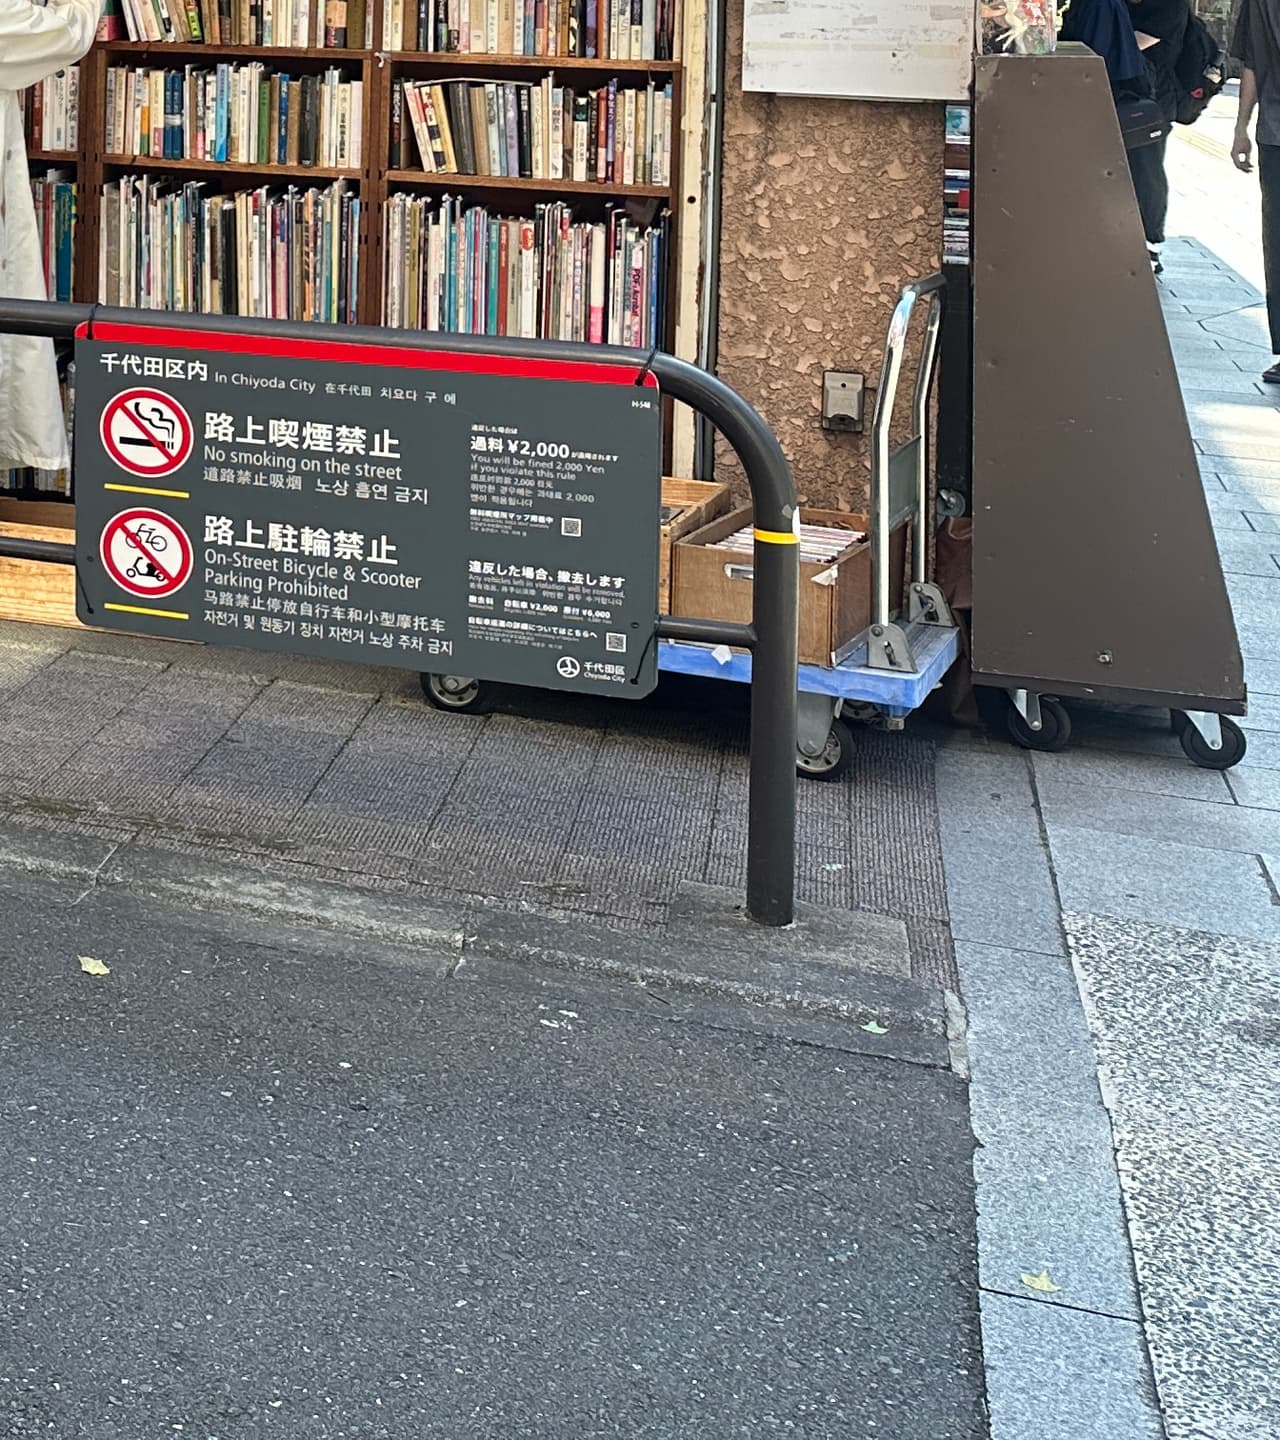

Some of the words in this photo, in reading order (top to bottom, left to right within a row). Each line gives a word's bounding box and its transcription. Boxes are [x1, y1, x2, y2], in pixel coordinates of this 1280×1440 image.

[100, 353, 208, 381] 千代田区内
[215, 372, 227, 383] In
[232, 373, 286, 390] Chiyoda
[290, 379, 316, 394] City
[425, 390, 437, 403] 구
[204, 412, 401, 459] 路上喫煙禁止
[471, 436, 504, 453] 過料
[507, 439, 570, 458] ¥2,000
[204, 447, 225, 461] No
[230, 451, 296, 472] smoking
[301, 458, 321, 472] on
[325, 457, 351, 475] the
[355, 462, 403, 480] street
[471, 454, 490, 463] You
[493, 456, 510, 465] will
[513, 458, 526, 466] be
[528, 460, 553, 470] fined
[585, 464, 605, 474] Yen
[480, 465, 498, 474] you
[501, 466, 533, 477] violate
[536, 469, 554, 479] this
[557, 471, 576, 480] rule
[203, 466, 302, 491] 道路禁止吸烟
[315, 479, 349, 497] 노상
[355, 482, 388, 500] 흡연
[394, 486, 428, 504] 금지
[204, 515, 398, 565] 路上駐輪禁止
[205, 549, 279, 571] On-Street
[283, 555, 338, 579] Bicycle
[343, 566, 355, 581] &
[360, 568, 423, 590] Scooter
[469, 560, 626, 589] 違反した場合、撤去します
[205, 568, 263, 594] Parking
[268, 575, 348, 601] Prohibited
[204, 610, 239, 627] 자전거
[243, 614, 255, 630] 및
[259, 616, 295, 636] 원동기
[328, 625, 365, 644] 자전거
[369, 630, 394, 648] 노상
[398, 634, 424, 652] 주차
[428, 637, 453, 656] 금지
